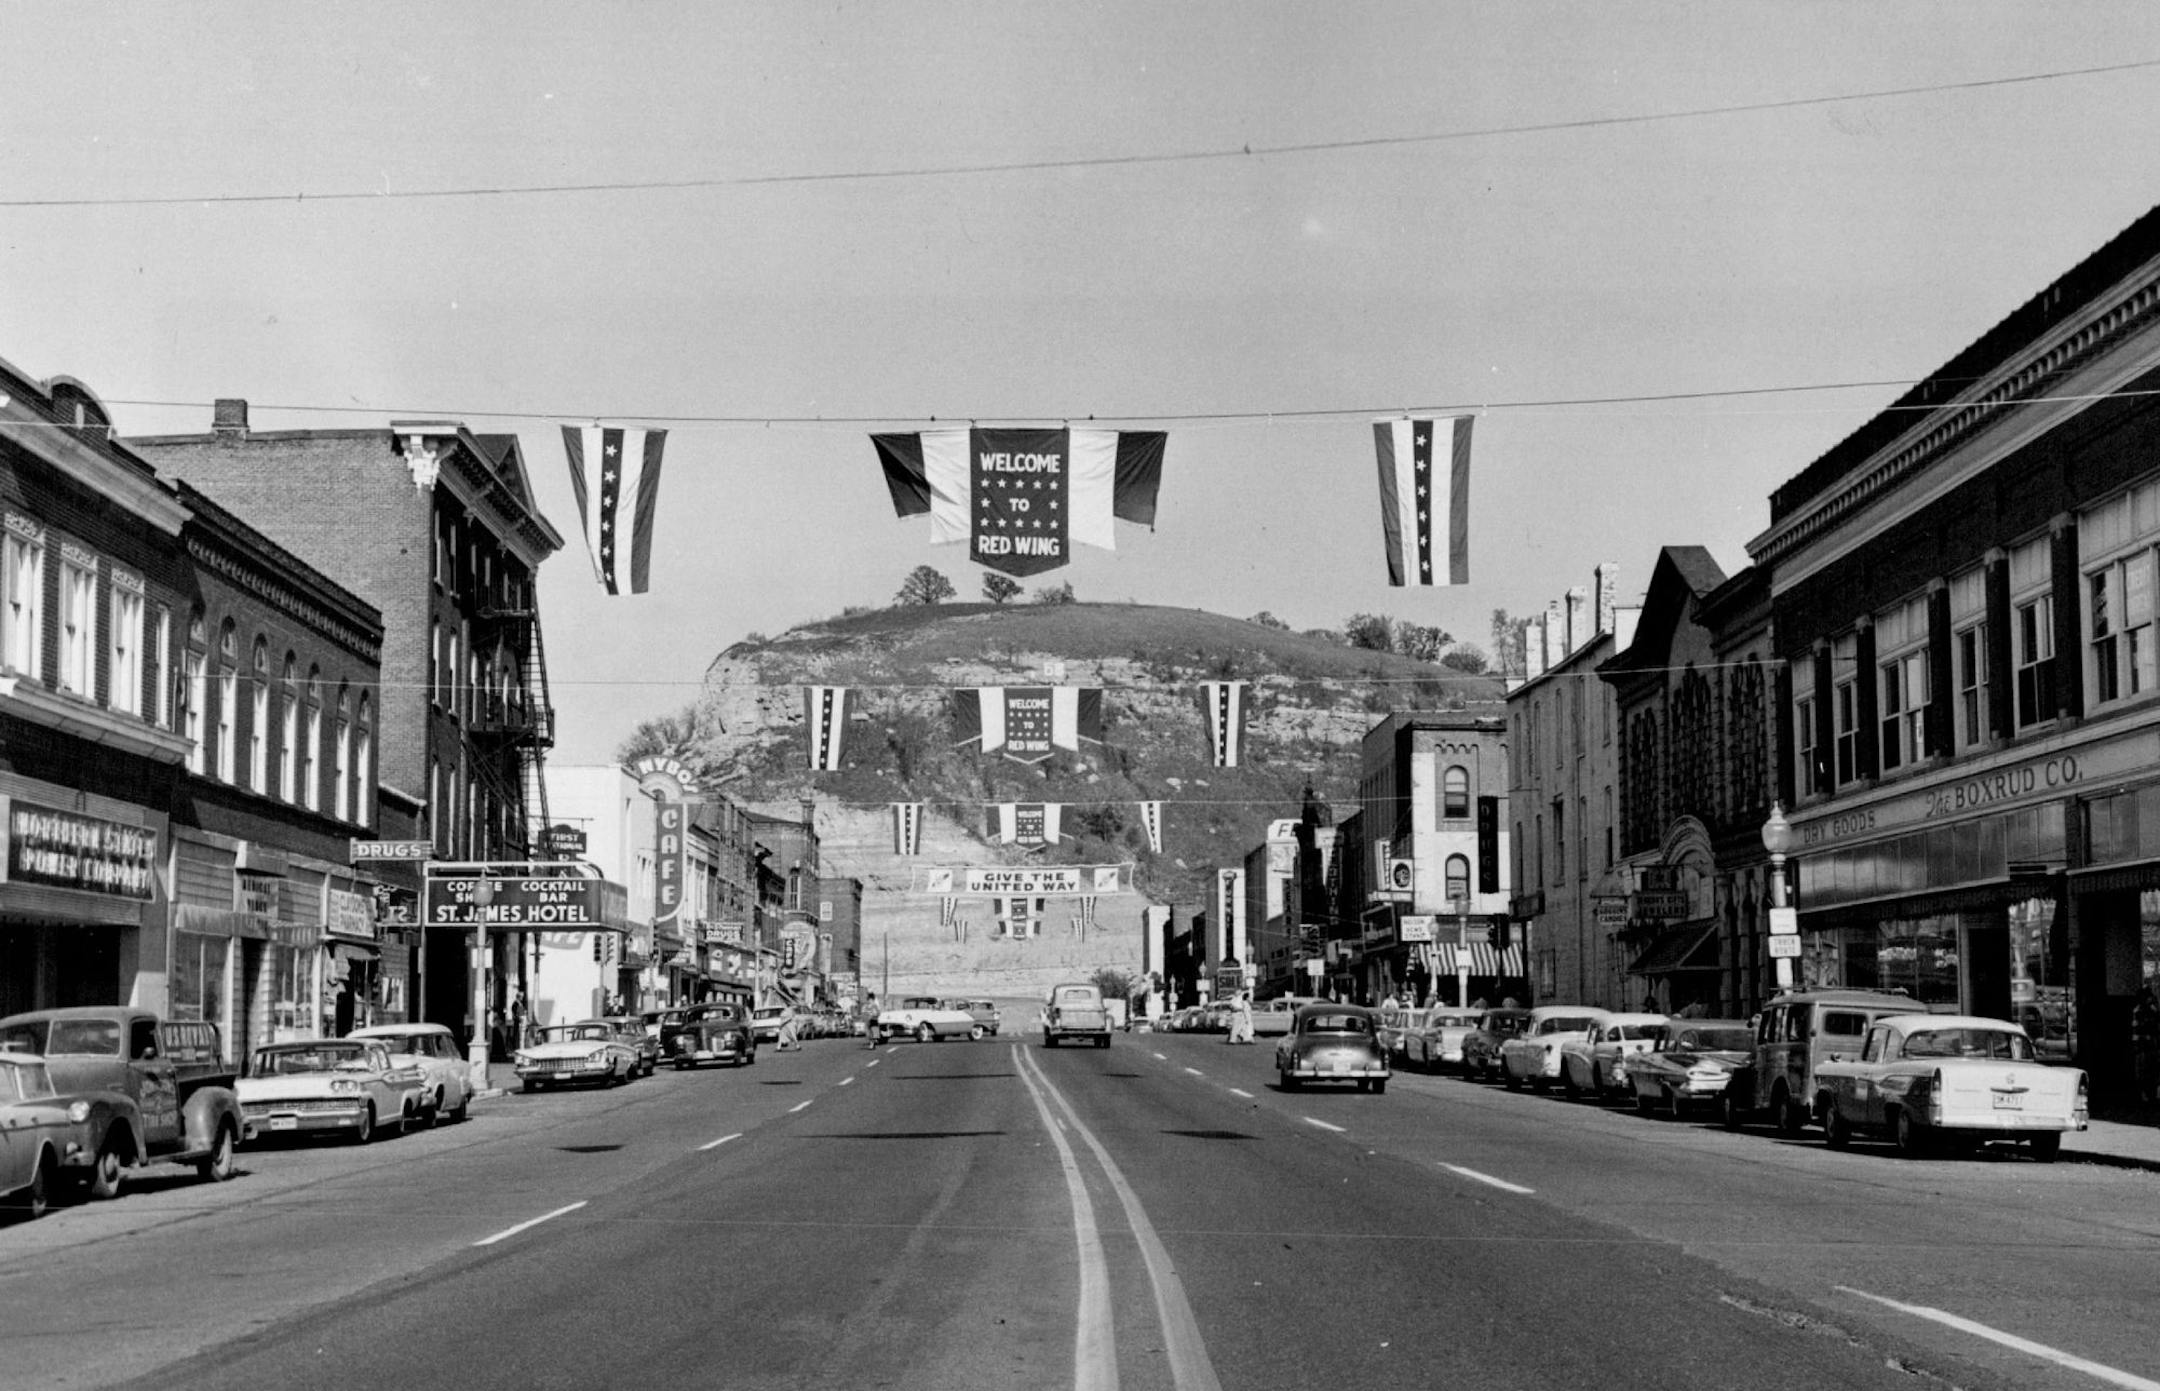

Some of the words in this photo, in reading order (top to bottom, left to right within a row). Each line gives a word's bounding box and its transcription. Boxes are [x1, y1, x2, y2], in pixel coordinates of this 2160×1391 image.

[979, 452, 1062, 473] WELCOME
[1008, 498, 1031, 512] TO
[978, 535, 1011, 554] RED
[1014, 536, 1061, 556] WING
[1008, 698, 1050, 710] WELCOME
[1022, 721, 1035, 730] TO
[1007, 740, 1025, 751] RED
[1026, 740, 1050, 751] WING
[1954, 767, 2036, 810] BOXRUD
[2044, 755, 2085, 789] CO.
[1803, 823, 1827, 844] DRY
[1833, 810, 1876, 839] GOODS
[357, 844, 421, 857] DRUGS
[661, 808, 679, 905] CAFE
[984, 872, 1024, 881] GIVE
[1031, 872, 1064, 881] THE
[446, 881, 503, 892] COFE
[520, 881, 586, 892] COCKTAIL
[971, 882, 1035, 891] UNITED
[1042, 882, 1076, 891] WAY
[539, 892, 569, 903] BAR
[436, 905, 465, 922] ST.
[527, 905, 590, 922] HOTEL
